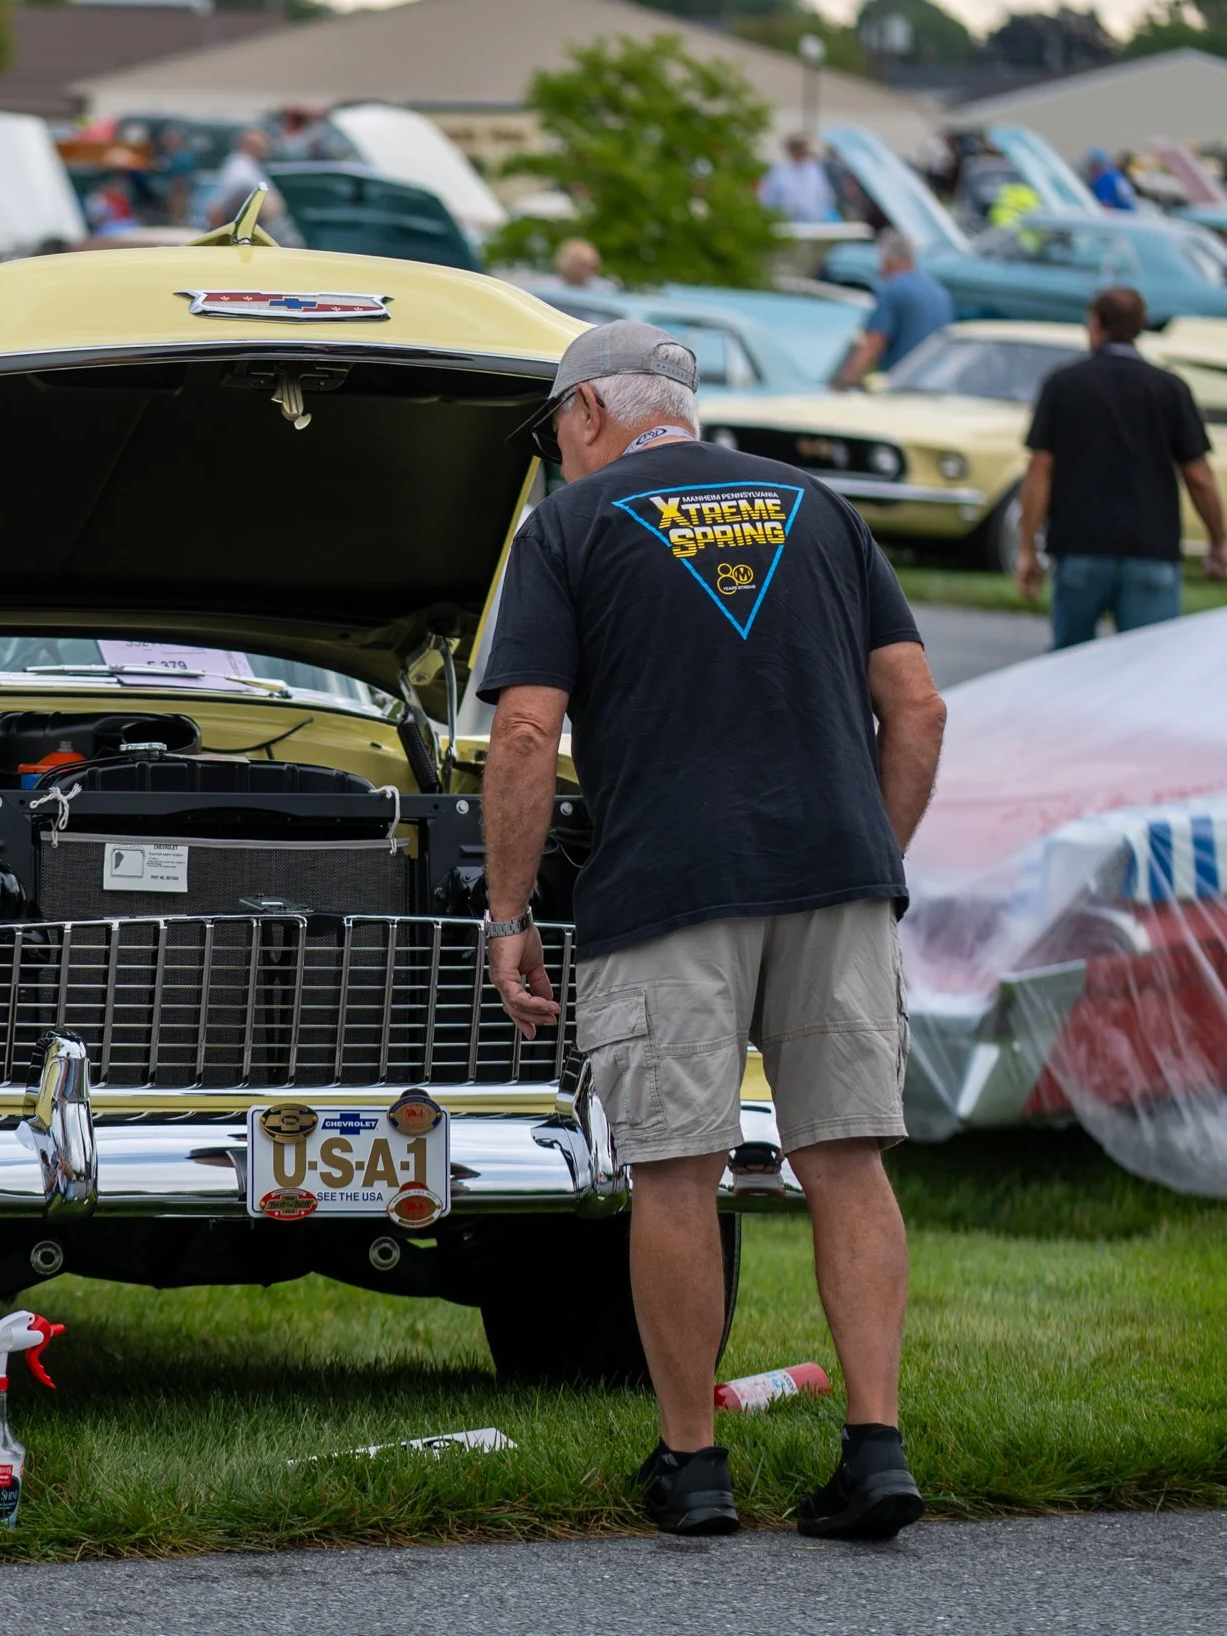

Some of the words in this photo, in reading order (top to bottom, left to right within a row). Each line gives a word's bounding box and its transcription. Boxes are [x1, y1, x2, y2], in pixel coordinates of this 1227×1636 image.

[682, 495, 721, 503] MANHEIM
[721, 491, 779, 501] PENNSYLVANIA
[649, 496, 786, 528] XTREME
[669, 521, 785, 558] SPRING
[325, 1120, 377, 1128] CHEVROLET
[317, 1192, 337, 1201] SEE
[339, 1192, 360, 1201] THE
[362, 1192, 383, 1201] USA
